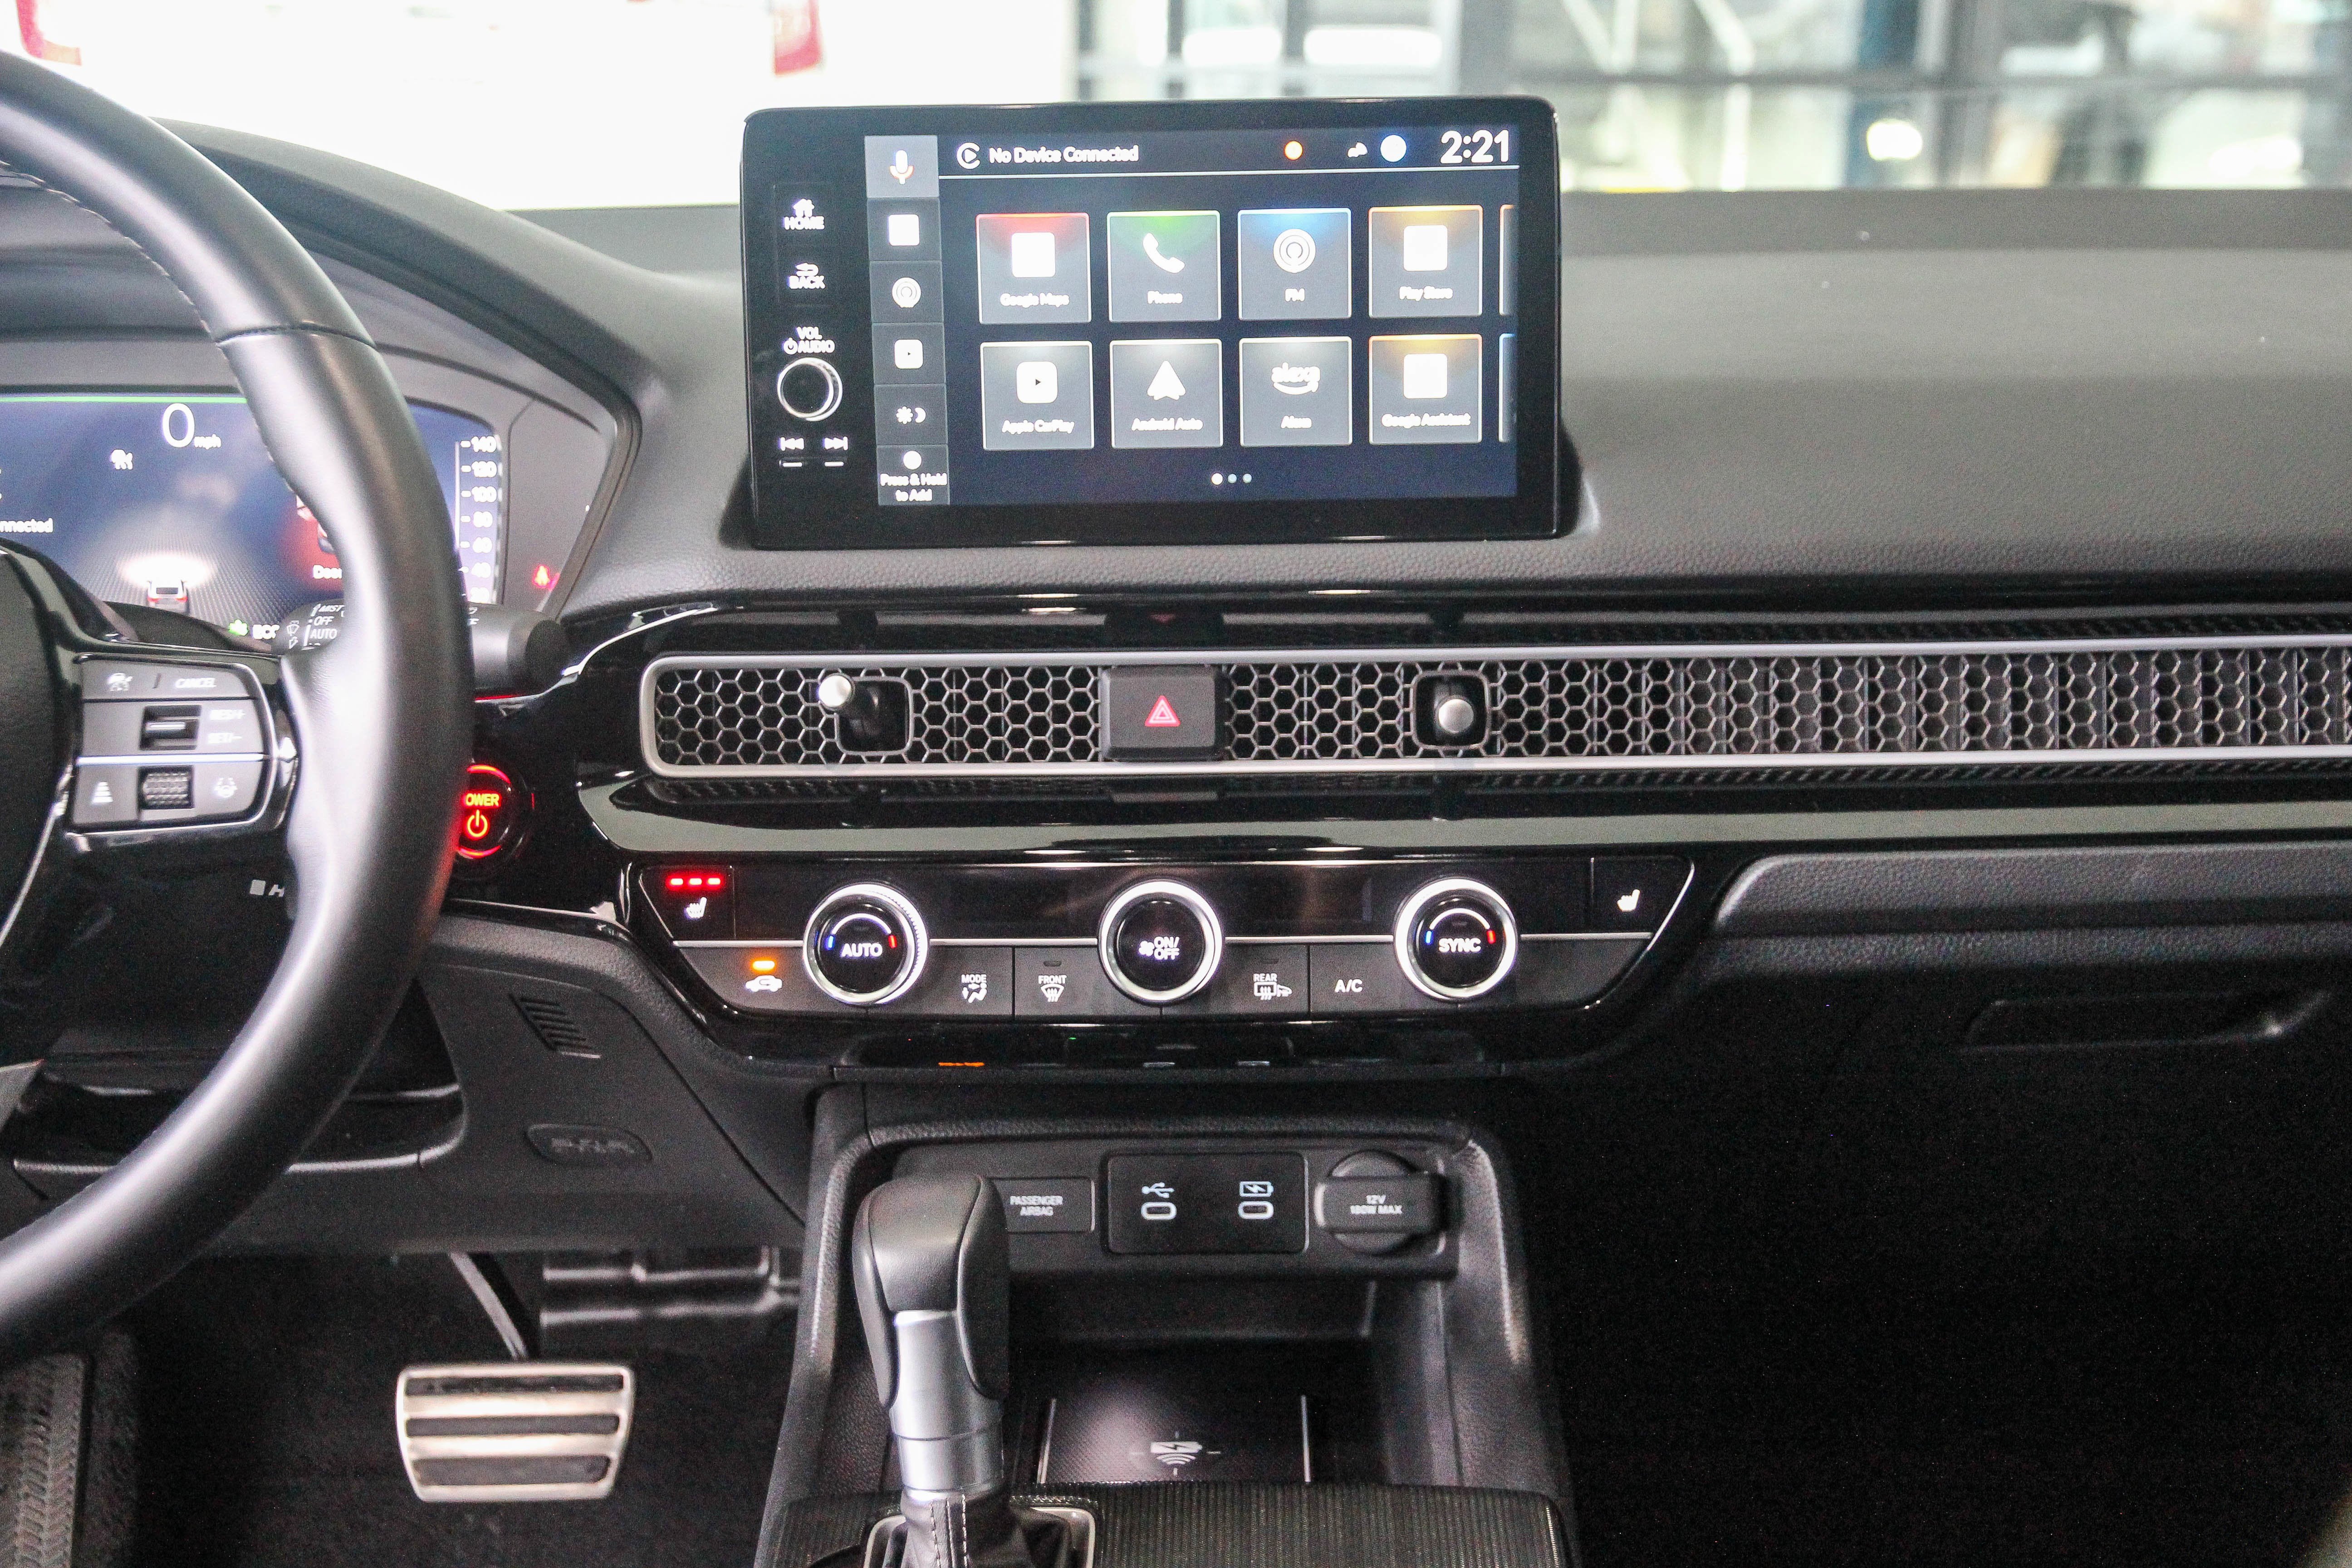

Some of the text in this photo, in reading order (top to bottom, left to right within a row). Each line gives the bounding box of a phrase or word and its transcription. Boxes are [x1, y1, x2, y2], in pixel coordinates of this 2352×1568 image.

[989, 145, 1139, 163] No Device Connected
[1440, 130, 1509, 164] 2:21
[784, 216, 825, 230] HOME
[789, 275, 826, 289] BACK
[1000, 292, 1070, 308] Google Maps
[797, 326, 823, 340] VOL
[798, 340, 835, 353] AUDIO
[162, 403, 221, 450] 0 mph
[1001, 419, 1075, 435] Apple CarPlay
[1131, 417, 1204, 431] Android Auto
[1382, 413, 1421, 429] Google
[471, 436, 497, 453] 140
[880, 473, 909, 486] Press
[921, 473, 947, 486] Hold
[895, 489, 933, 502] to Add
[314, 616, 334, 626] OFF
[310, 628, 338, 639] AUTO
[175, 677, 217, 689] CANCEL
[466, 793, 500, 807] OWER
[841, 942, 883, 958] AUTO
[1438, 937, 1482, 953] SYNC
[1154, 948, 1180, 960] OFF
[961, 974, 987, 984] MODE
[1038, 975, 1067, 985] FRONT
[1253, 973, 1278, 982] REAR
[1334, 979, 1363, 993] A/C
[1009, 1195, 1063, 1205] PASSENGER
[1366, 1194, 1387, 1205] 12V
[1020, 1205, 1054, 1216] AIRBAG
[1377, 1205, 1403, 1215] MAX
